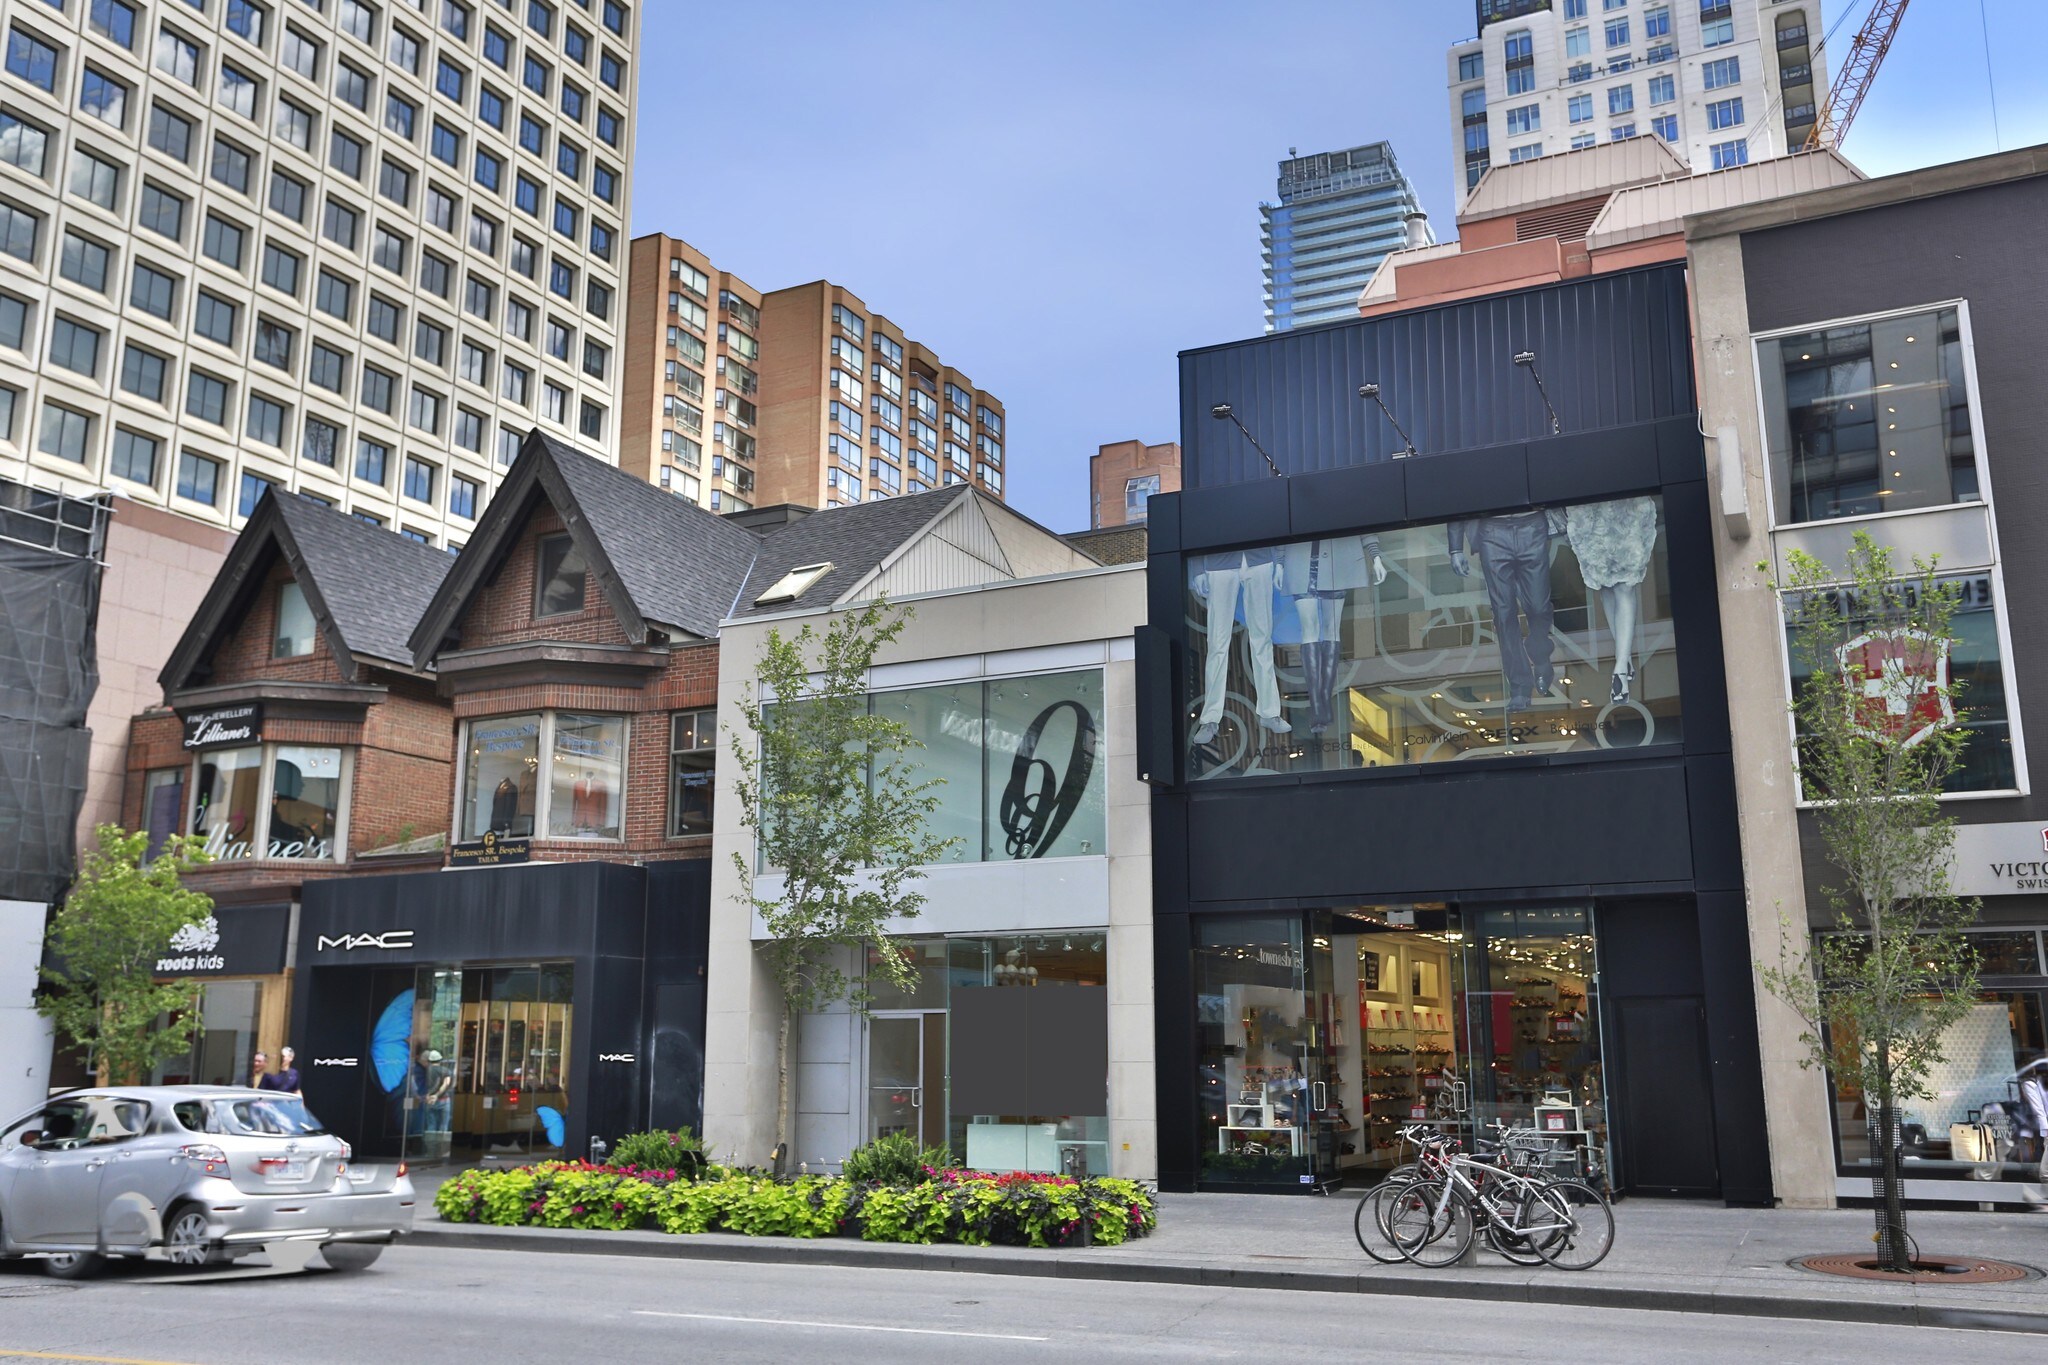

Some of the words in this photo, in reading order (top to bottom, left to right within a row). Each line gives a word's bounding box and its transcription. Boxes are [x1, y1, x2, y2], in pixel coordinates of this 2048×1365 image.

[186, 714, 205, 724] FINE
[211, 707, 254, 721] JEWELLERY
[184, 716, 251, 747] Lilliane's
[1406, 733, 1441, 746] Calvin
[1443, 731, 1469, 743] Klein
[1479, 725, 1540, 740] GEOX
[194, 805, 330, 861] lliane's
[453, 848, 484, 858] Francesco
[498, 845, 526, 856] Bespoke
[155, 955, 195, 971] roots
[196, 954, 225, 970] kids
